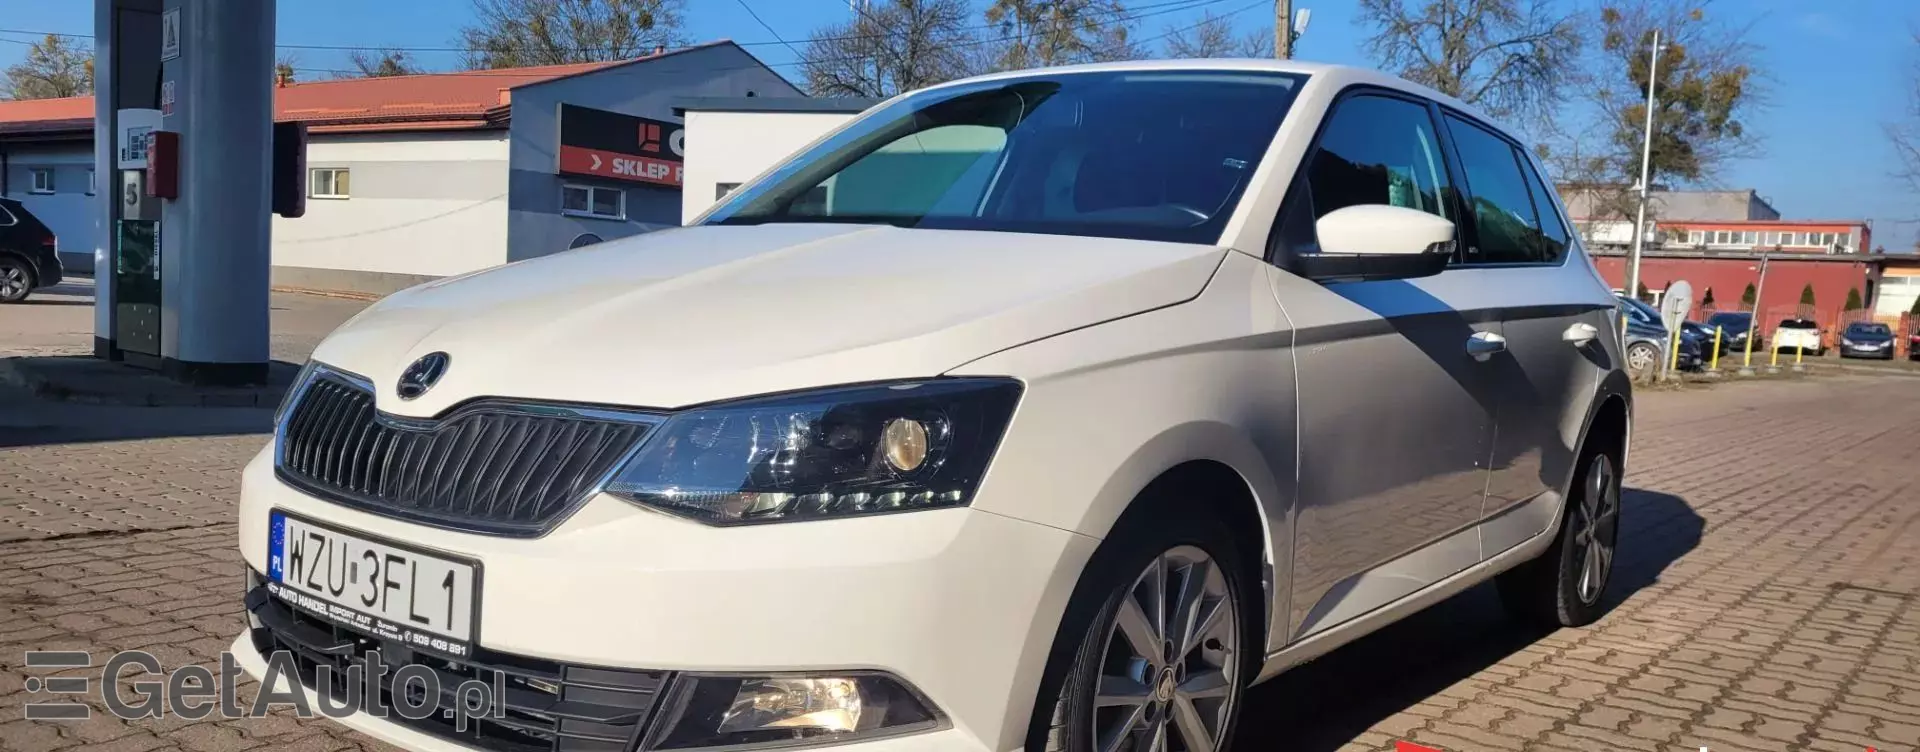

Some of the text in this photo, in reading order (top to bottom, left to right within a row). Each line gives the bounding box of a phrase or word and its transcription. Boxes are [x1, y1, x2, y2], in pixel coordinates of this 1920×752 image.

[612, 158, 670, 180] SKLEP
[126, 183, 138, 206] 5
[272, 555, 282, 572] PL
[289, 525, 455, 631] WZU 3FL1
[279, 587, 329, 615] AUTO HANDEL
[329, 604, 356, 620] IMPORT
[356, 614, 372, 625] AUT
